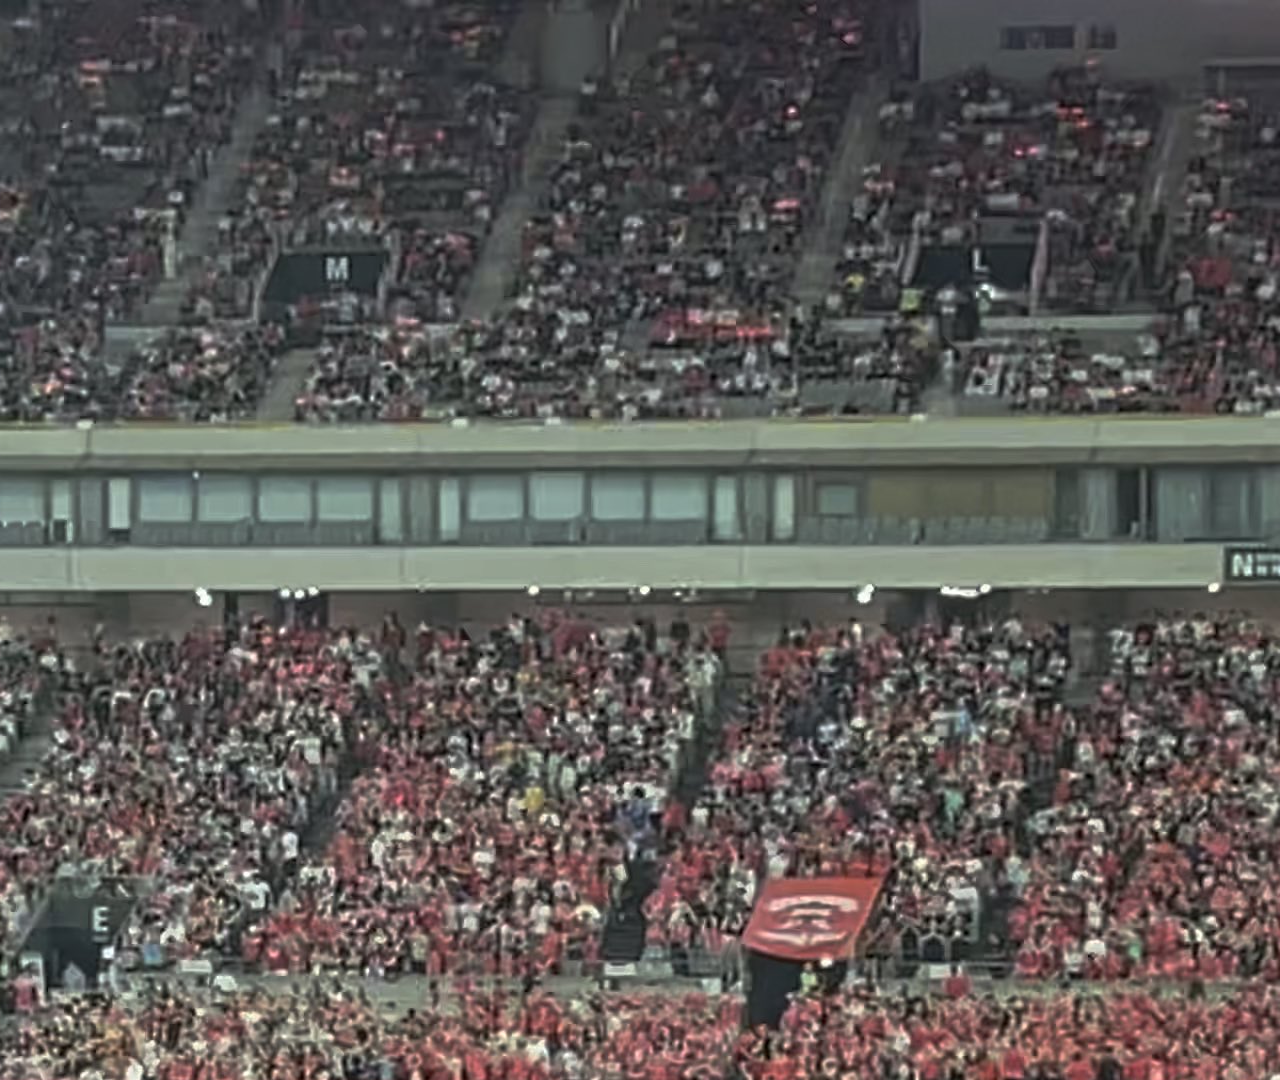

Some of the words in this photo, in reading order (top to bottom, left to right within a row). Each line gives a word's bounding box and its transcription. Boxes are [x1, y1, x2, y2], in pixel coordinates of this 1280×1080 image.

[326, 257, 349, 280] M
[973, 249, 988, 272] L
[1232, 553, 1252, 576] N
[93, 907, 108, 931] E
